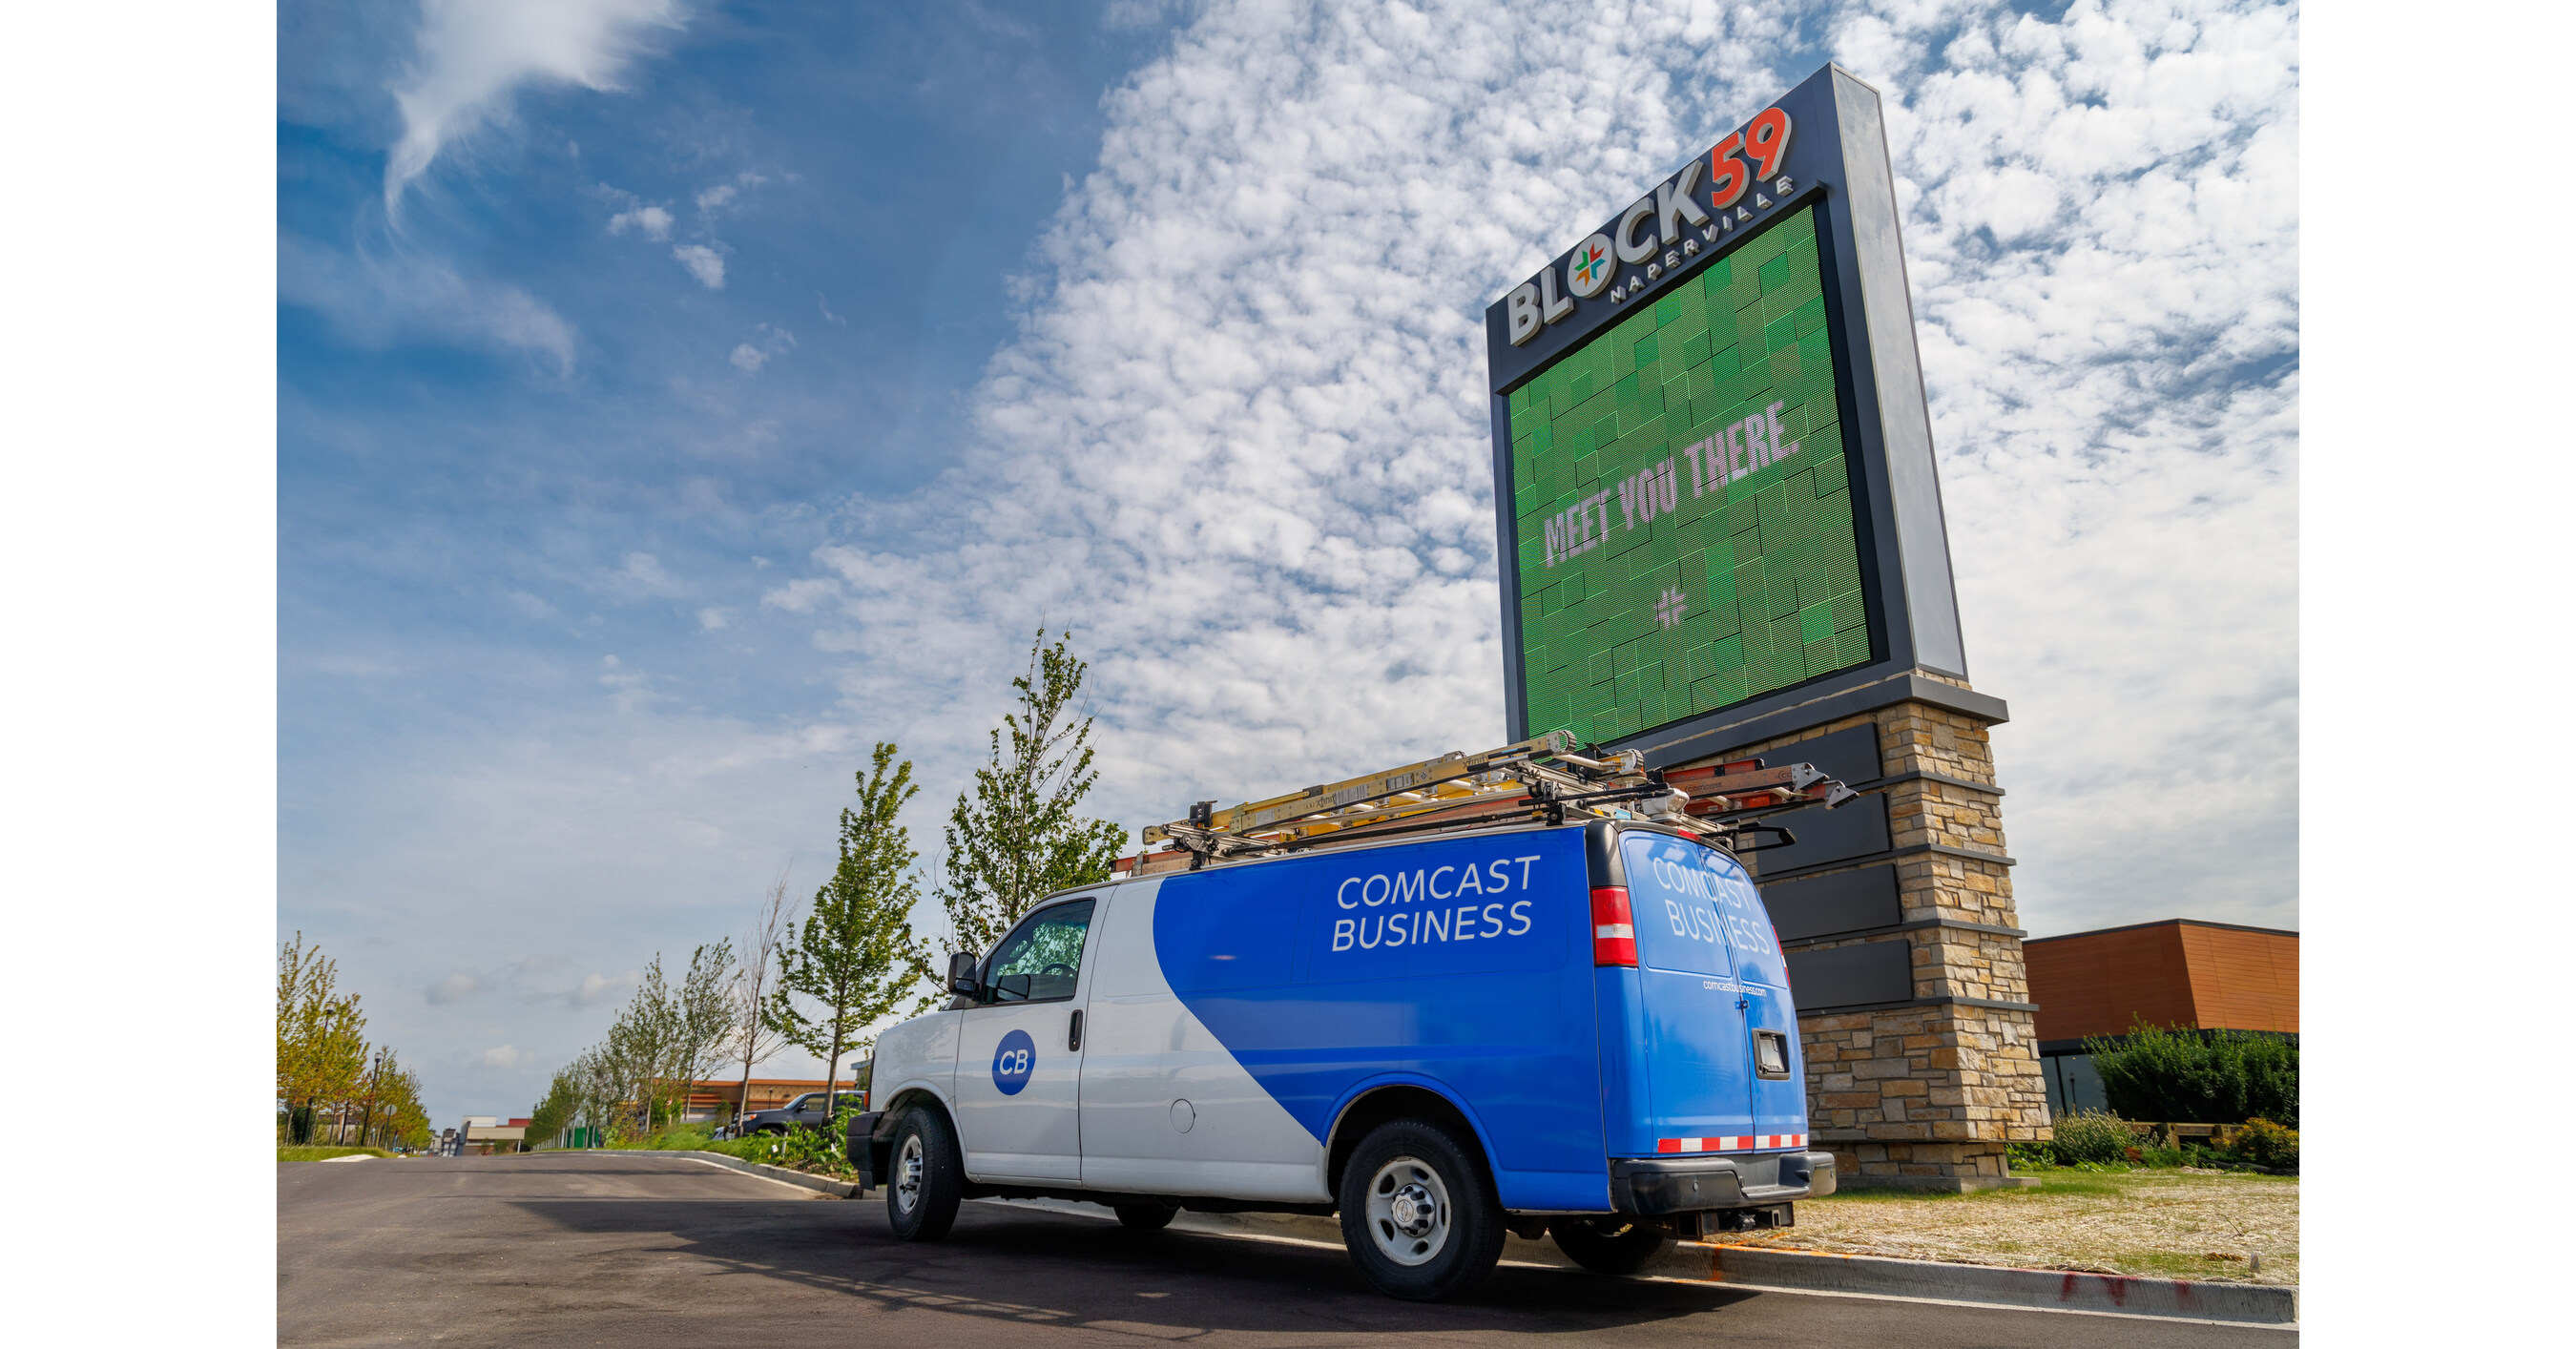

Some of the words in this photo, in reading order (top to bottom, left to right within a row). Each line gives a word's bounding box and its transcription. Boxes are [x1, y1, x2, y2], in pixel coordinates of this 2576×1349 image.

[1610, 176, 1795, 305] NAPERVILLE
[1544, 488, 1610, 569] MEET
[1618, 456, 1677, 530] YOU
[1684, 400, 1800, 499] THERE.
[1337, 855, 1541, 910] COMCAST
[1652, 857, 1752, 912] COMCAST
[1332, 901, 1532, 952] BUSINESS
[1664, 899, 1771, 955] BUSINESS
[1703, 980, 1768, 998] comcastbusiness.com
[999, 1048, 1028, 1075] CB
